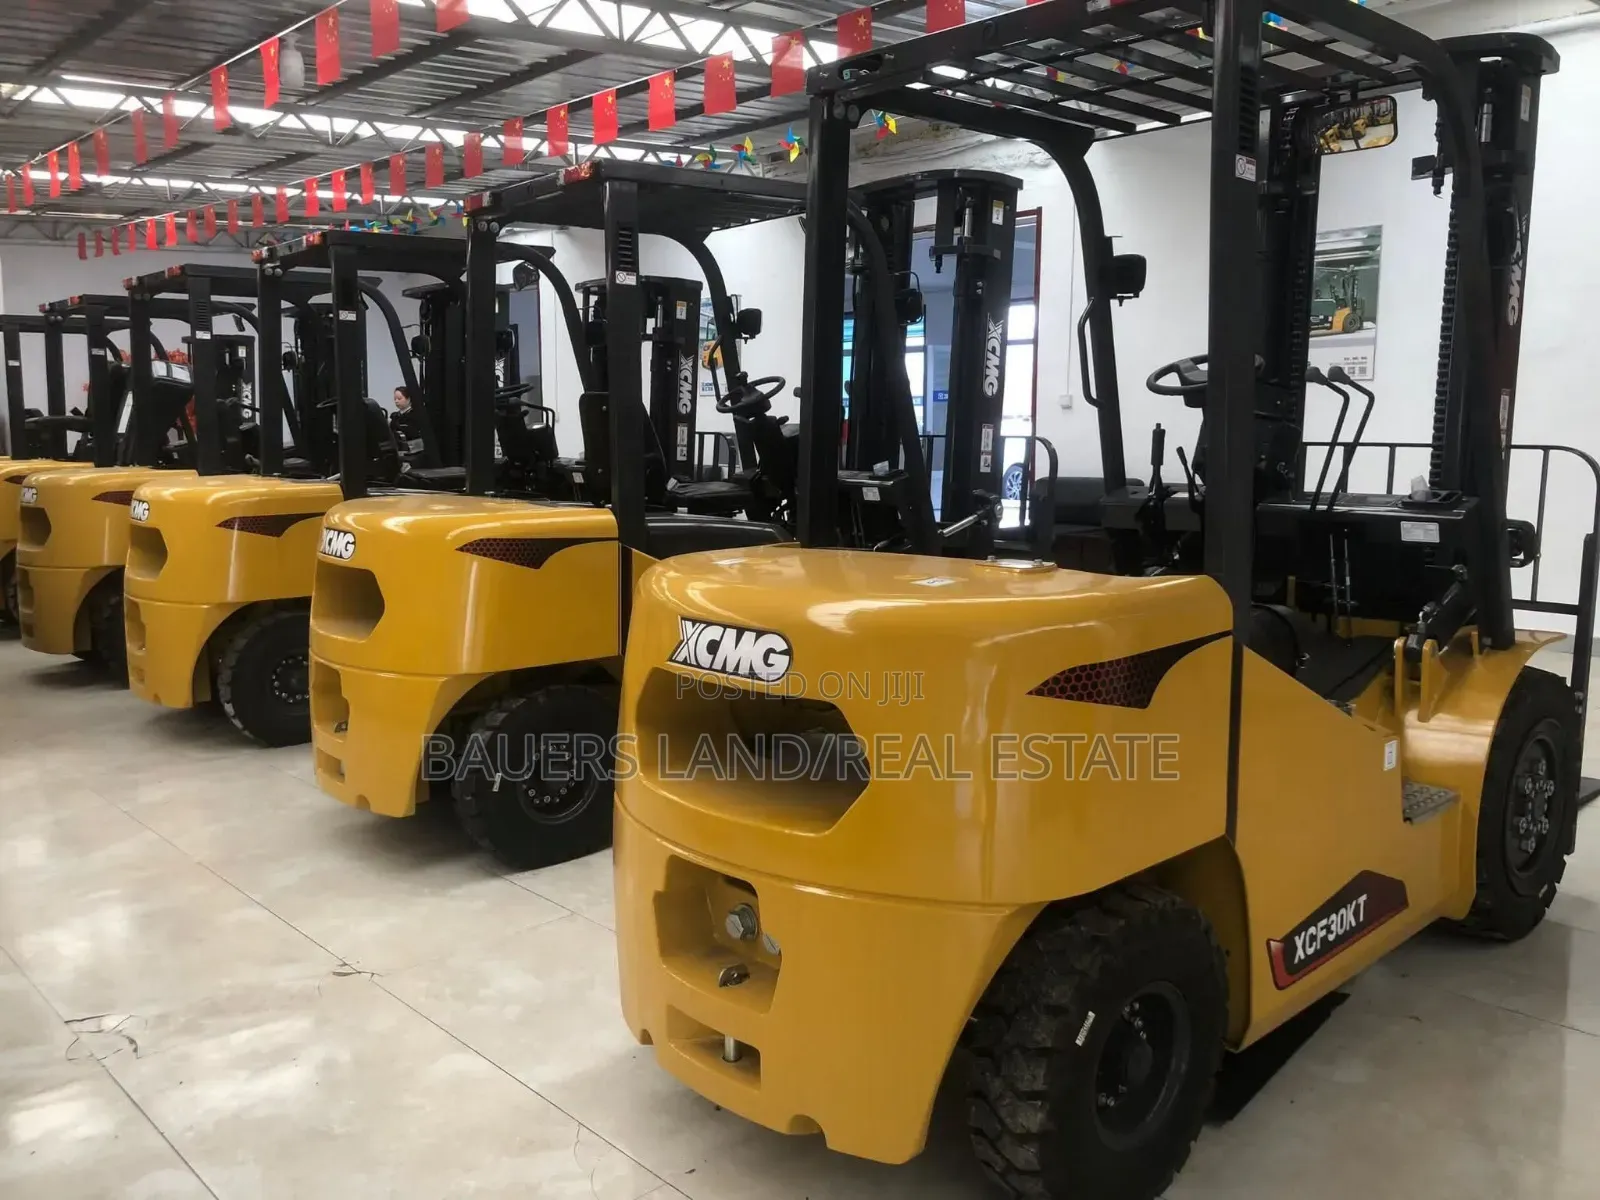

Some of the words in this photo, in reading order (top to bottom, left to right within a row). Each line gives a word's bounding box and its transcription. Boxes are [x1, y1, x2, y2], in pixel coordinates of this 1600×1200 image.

[679, 354, 694, 415] XCMG
[983, 318, 1004, 397] XCMG
[671, 618, 791, 683] XCMG
[1293, 893, 1368, 965] XCF30KT
